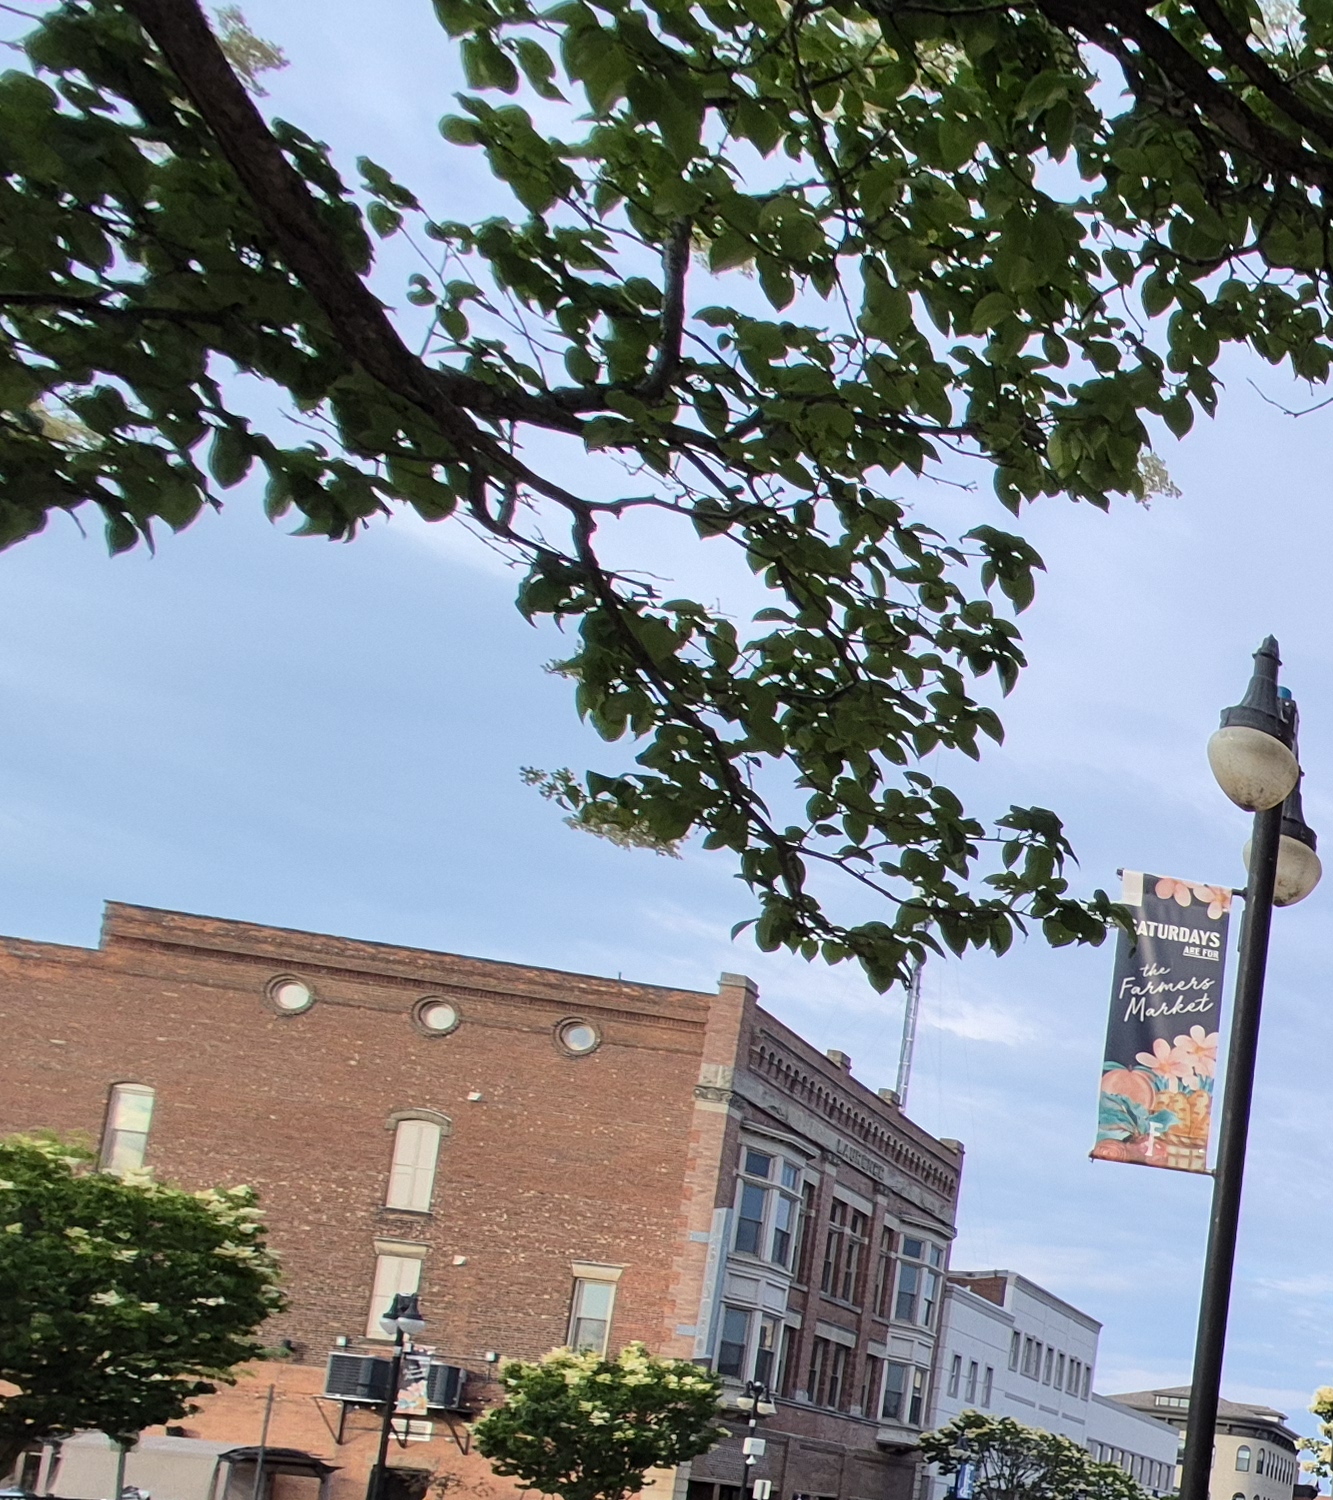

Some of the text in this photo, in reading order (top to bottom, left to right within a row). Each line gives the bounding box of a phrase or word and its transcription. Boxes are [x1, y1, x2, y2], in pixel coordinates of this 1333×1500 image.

[1184, 945, 1219, 960] ARE FOR
[1139, 963, 1170, 976] the
[1119, 976, 1215, 1000] Farmers
[1123, 994, 1214, 1023] Market
